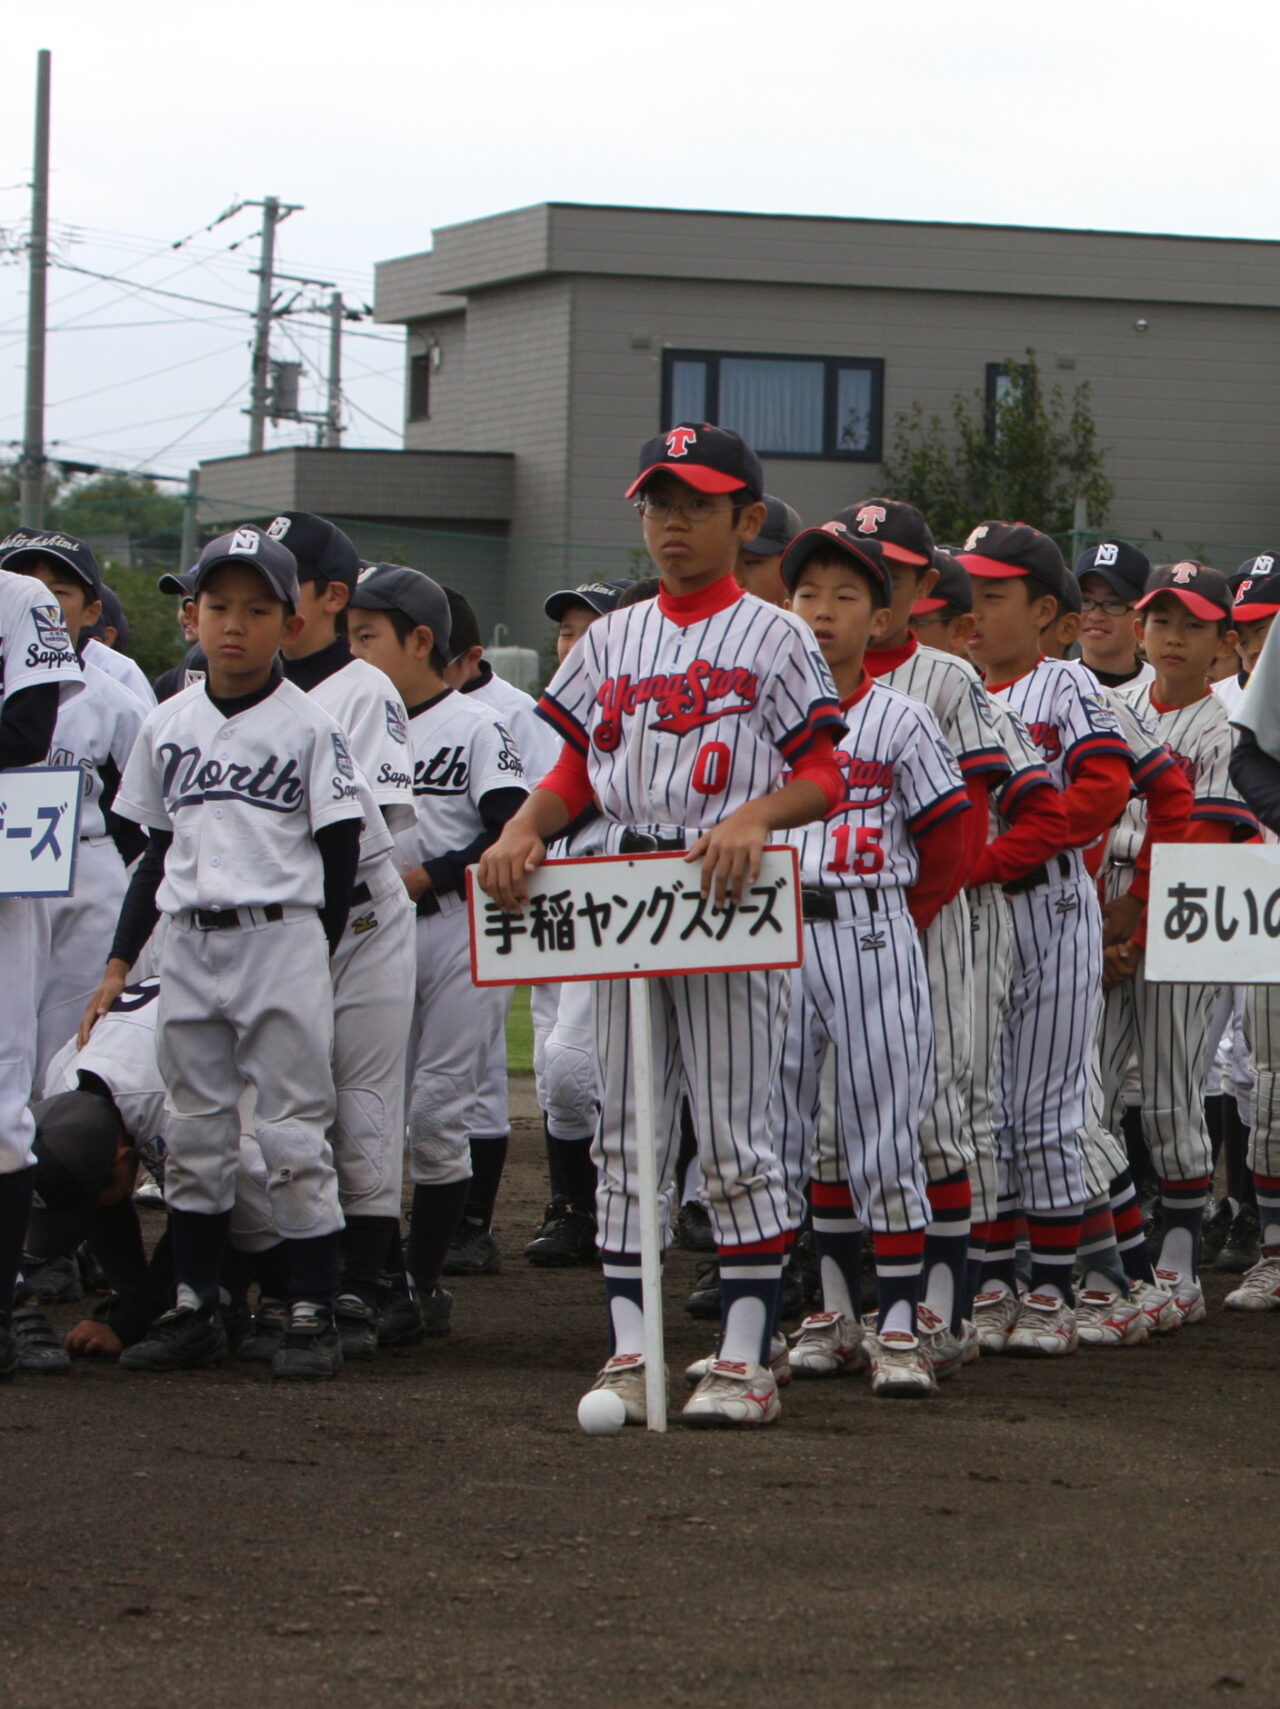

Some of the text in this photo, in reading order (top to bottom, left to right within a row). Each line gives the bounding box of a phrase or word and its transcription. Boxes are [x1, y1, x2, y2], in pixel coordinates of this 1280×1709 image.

[665, 426, 697, 458] T
[856, 505, 887, 534] T
[1171, 562, 1197, 584] T
[159, 743, 304, 804] North
[691, 741, 732, 796] 0
[0, 801, 69, 862] ーズ
[826, 824, 885, 875] 15
[483, 876, 788, 955] 手稲ヤングスターズ
